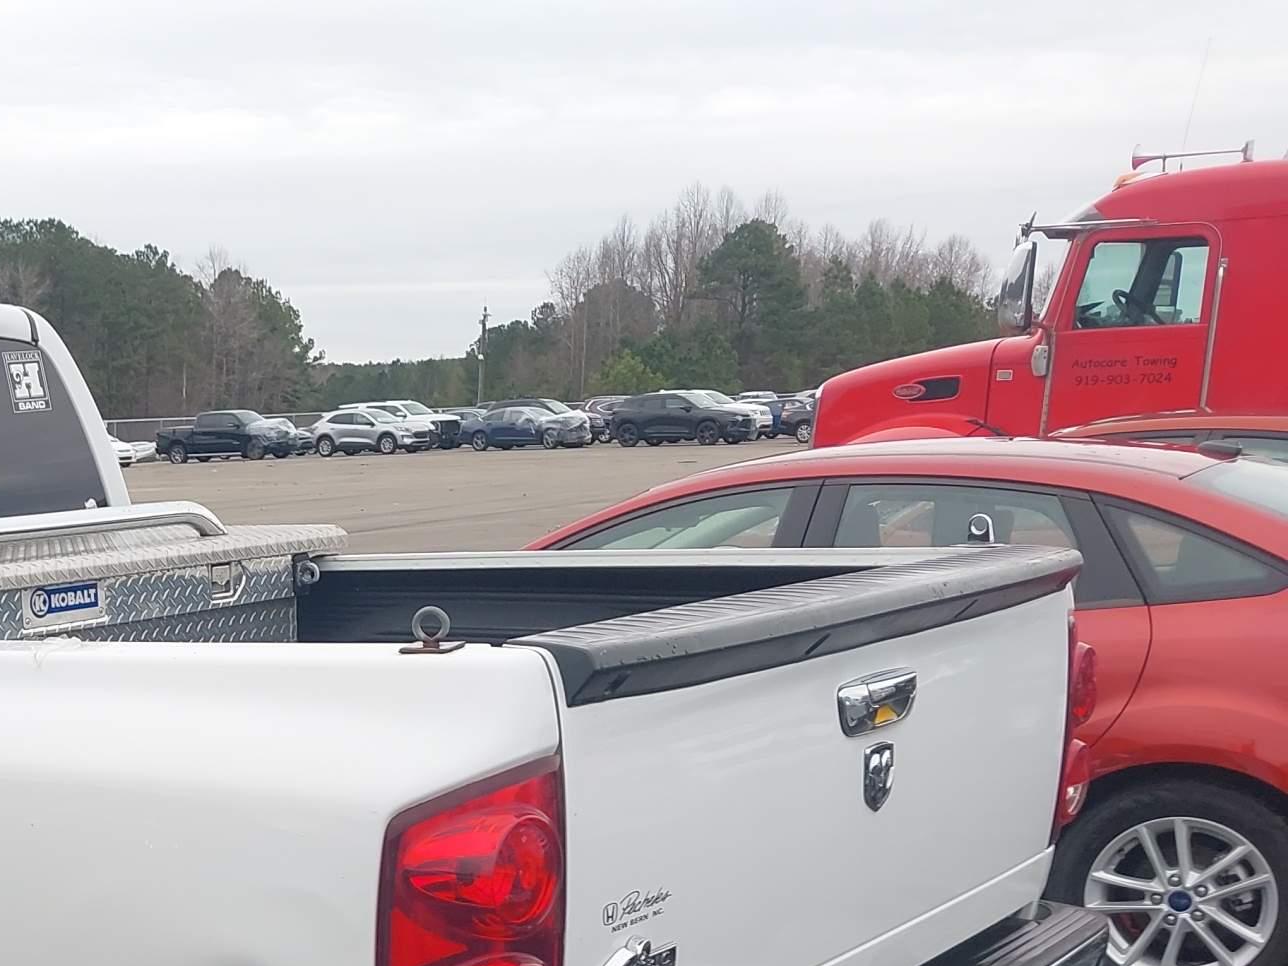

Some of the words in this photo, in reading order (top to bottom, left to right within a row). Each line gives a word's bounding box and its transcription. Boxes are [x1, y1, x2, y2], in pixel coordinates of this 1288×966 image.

[1072, 358, 1128, 369] Autocare
[1134, 355, 1178, 368] Towing
[1074, 372, 1172, 387] 919-903-7024
[18, 400, 46, 411] BAND
[50, 588, 97, 609] KOBALT
[611, 920, 629, 934] NEW
